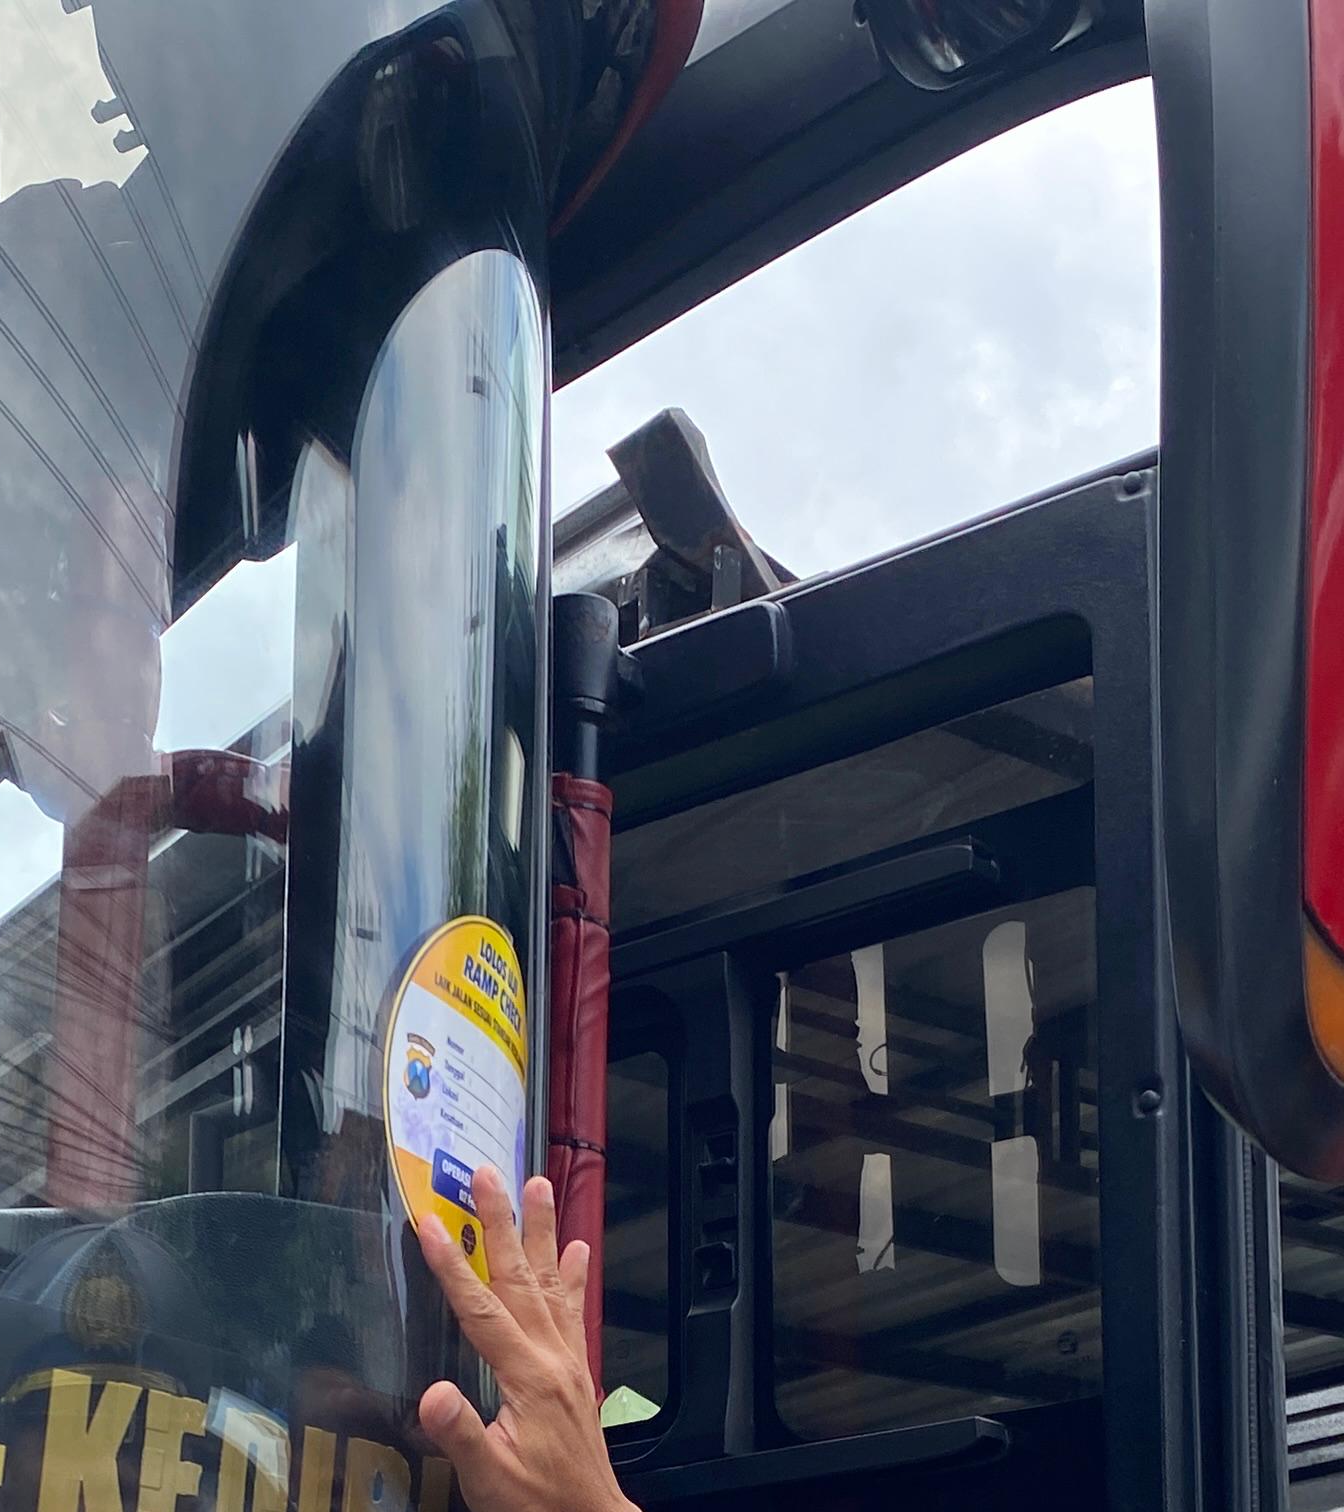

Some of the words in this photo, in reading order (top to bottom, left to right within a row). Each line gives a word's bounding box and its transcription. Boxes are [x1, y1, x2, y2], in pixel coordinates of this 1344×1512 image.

[480, 937, 507, 977] LOLOS
[464, 955, 499, 999] RAMP
[452, 984, 472, 1011] JALAN
[442, 1159, 471, 1188] OPERASI
